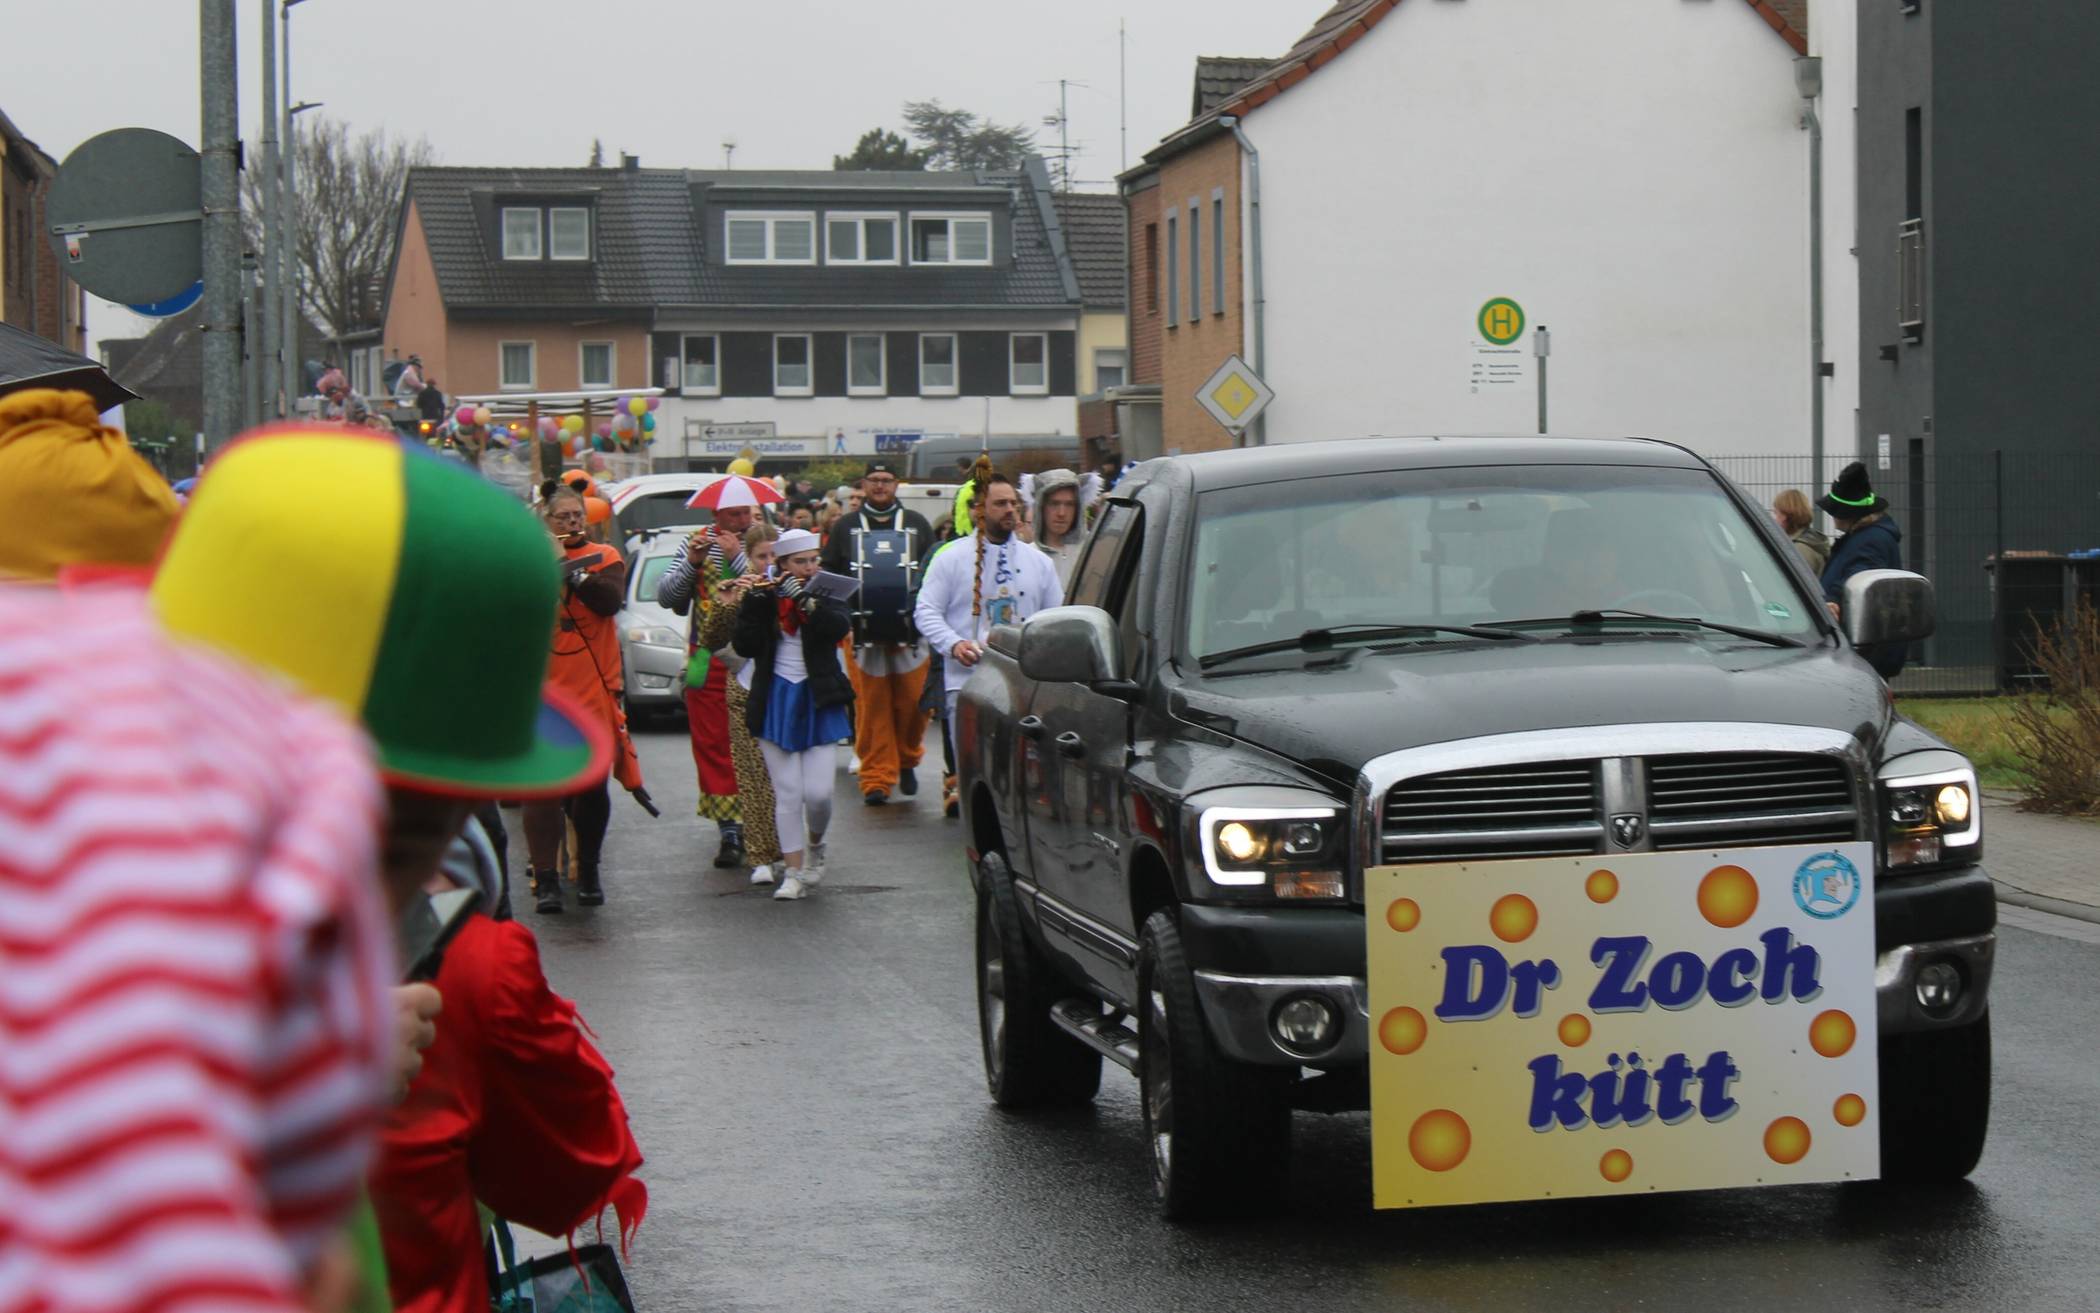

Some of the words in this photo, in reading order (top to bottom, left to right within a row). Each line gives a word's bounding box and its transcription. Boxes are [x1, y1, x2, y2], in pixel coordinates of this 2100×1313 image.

[1491, 307, 1511, 335] H
[1435, 944, 1561, 1022] Dr
[1588, 926, 1823, 1014] Zoch
[1528, 1051, 1740, 1132] kütt
